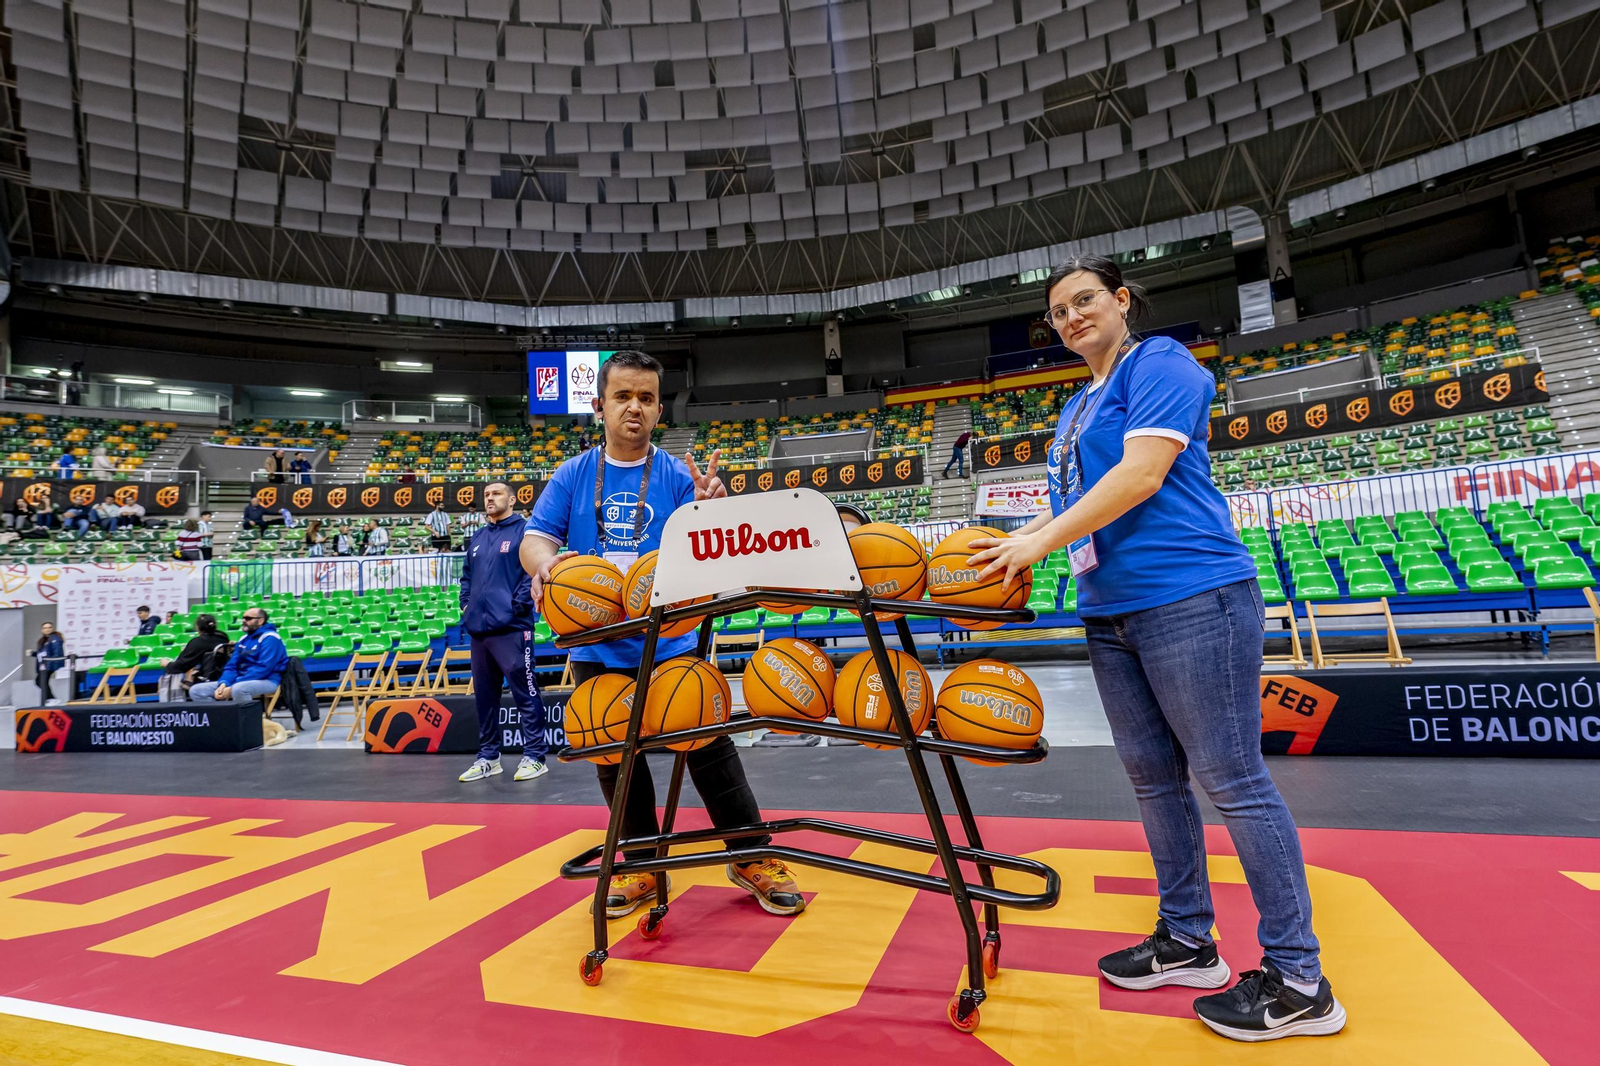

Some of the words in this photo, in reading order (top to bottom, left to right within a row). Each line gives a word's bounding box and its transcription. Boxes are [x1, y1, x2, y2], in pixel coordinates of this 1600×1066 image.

[989, 483, 1047, 491] BURGOS
[687, 522, 812, 562] Wilson
[762, 652, 816, 709] Wilson
[1404, 676, 1600, 710] FEDERACIÓ
[864, 694, 876, 719] FEB
[960, 689, 1032, 728] Wilson
[1261, 679, 1319, 718] FEB
[47, 711, 66, 732] FEB
[90, 711, 152, 729] FEDERACIÓN
[154, 710, 210, 728] ESPAÑOLA
[417, 702, 443, 729] FEB
[91, 731, 105, 745] DE
[106, 730, 175, 746] BALONCESTO
[1409, 717, 1451, 742] DE
